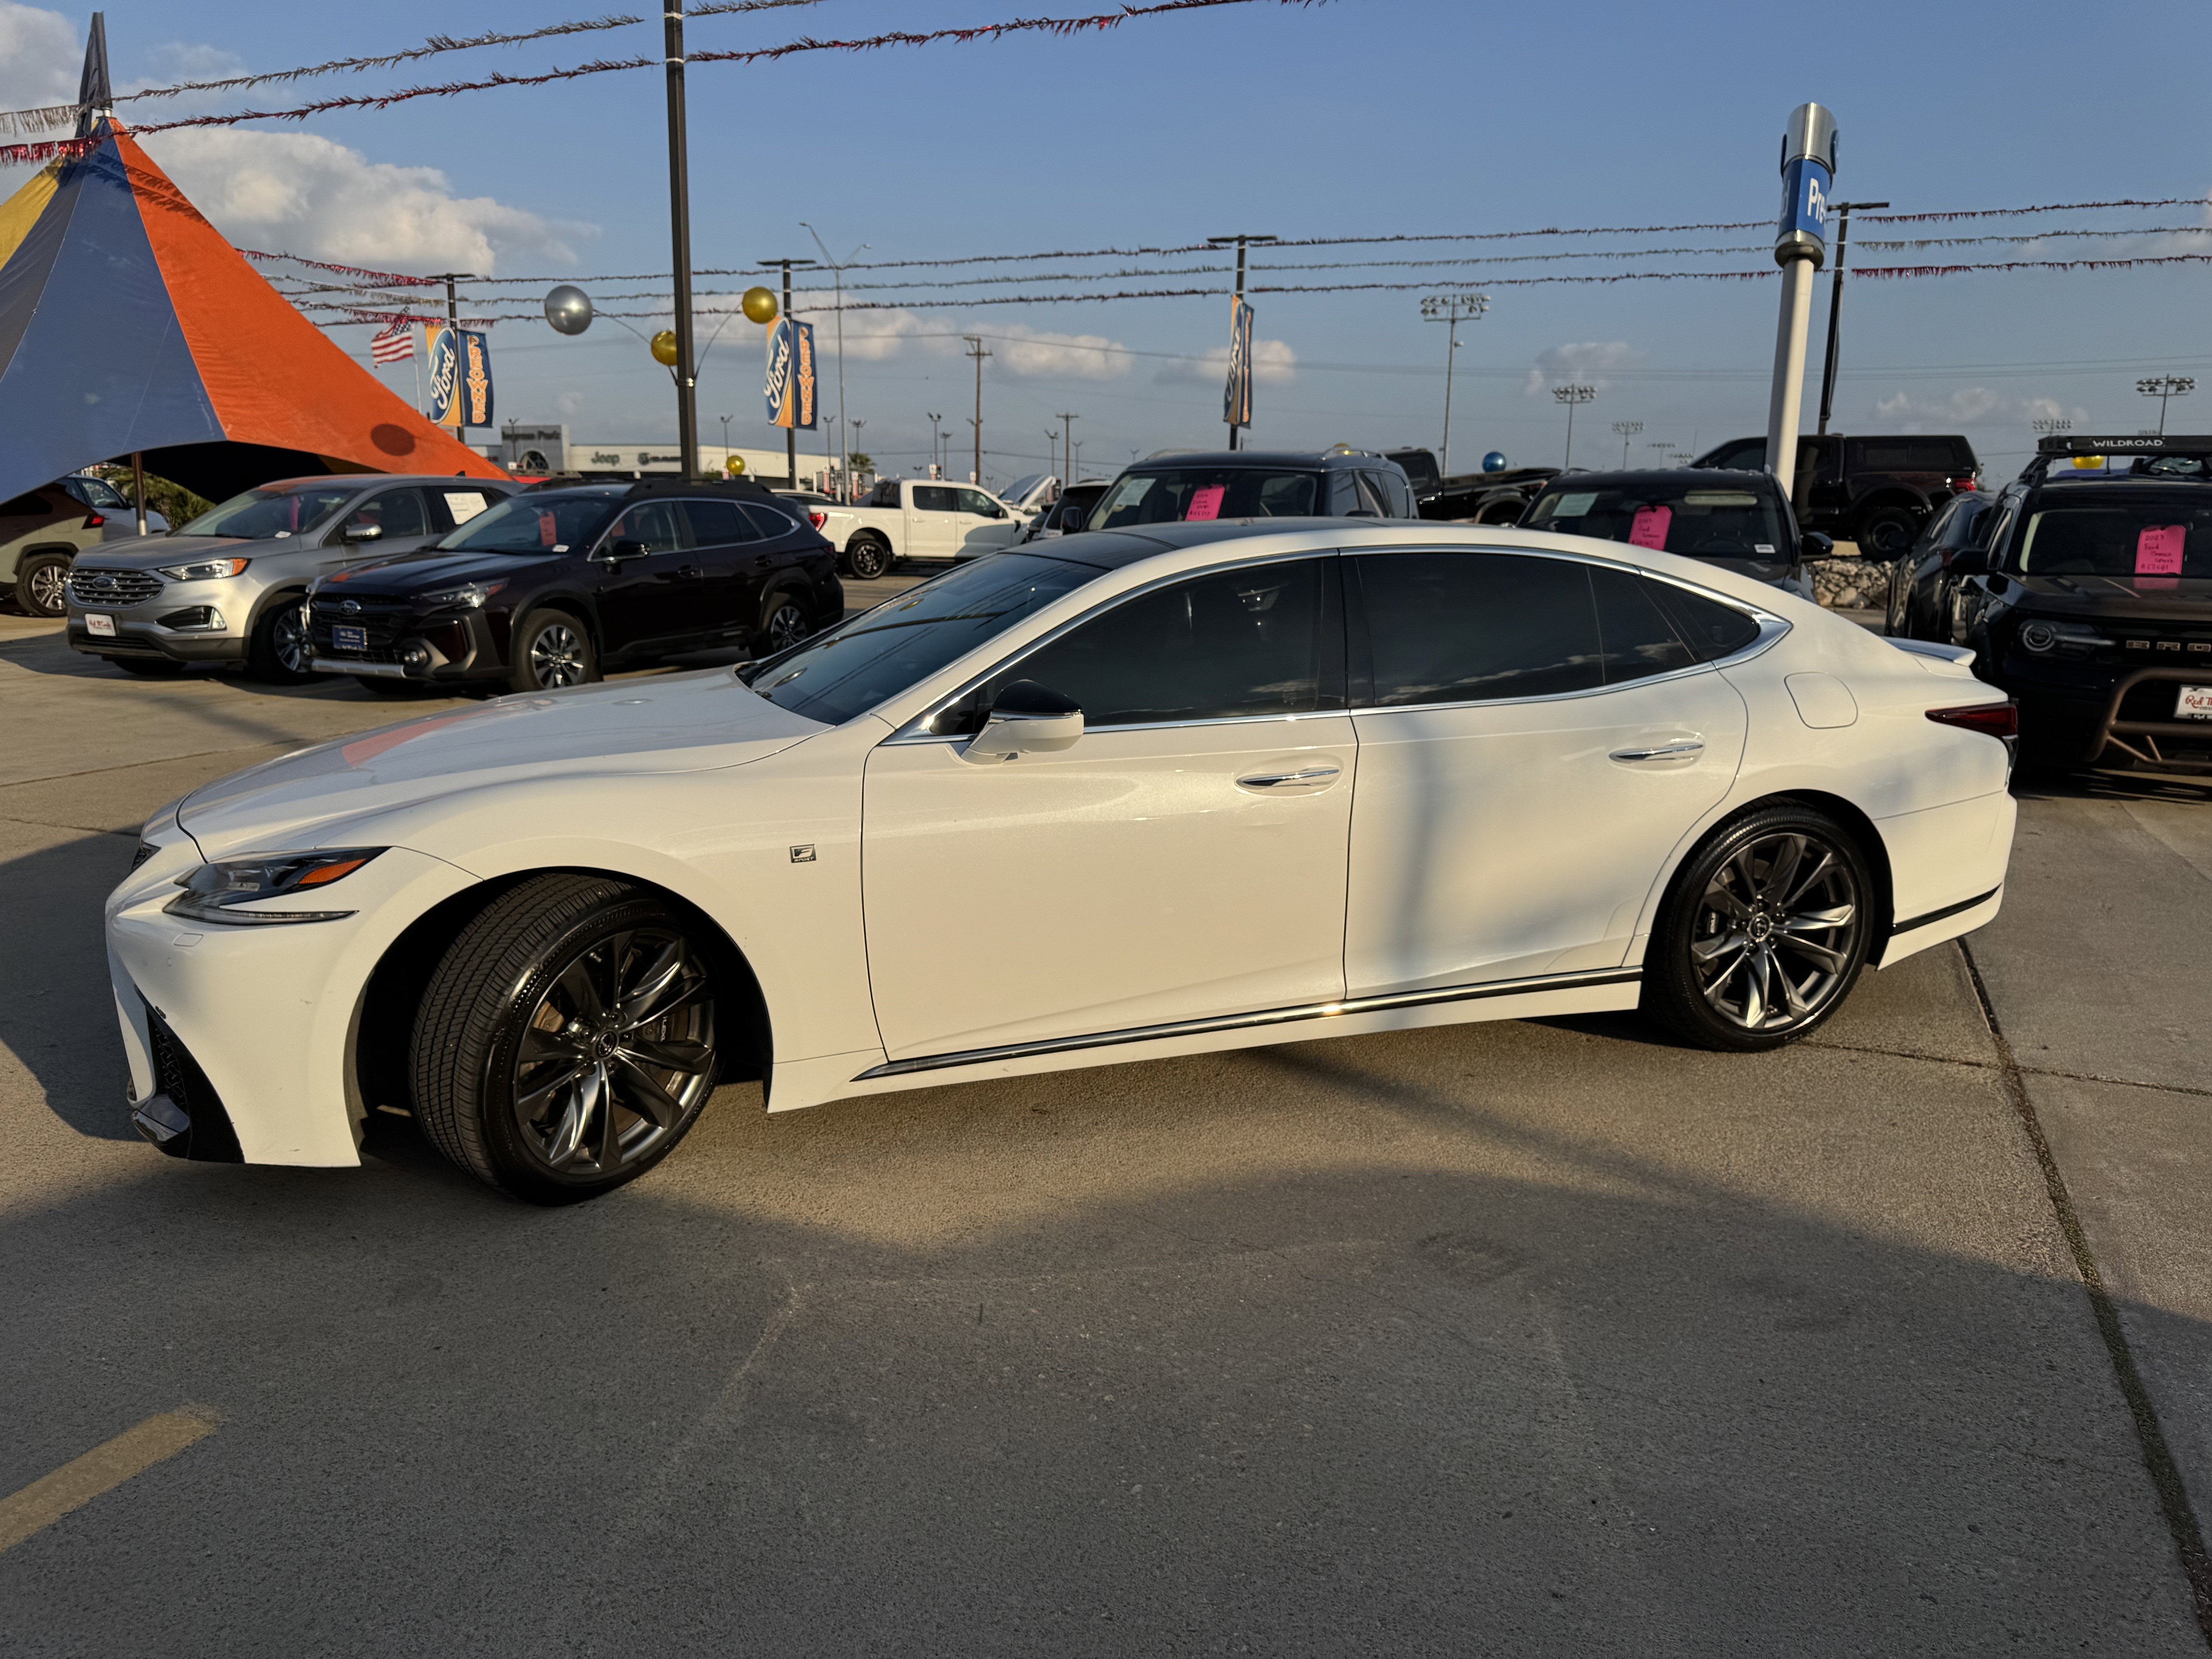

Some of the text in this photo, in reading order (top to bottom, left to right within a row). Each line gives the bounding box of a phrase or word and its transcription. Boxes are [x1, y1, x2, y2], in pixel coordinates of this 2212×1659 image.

[430, 342, 455, 410] Ford
[763, 334, 790, 409] Ford
[591, 452, 620, 466] Jeep
